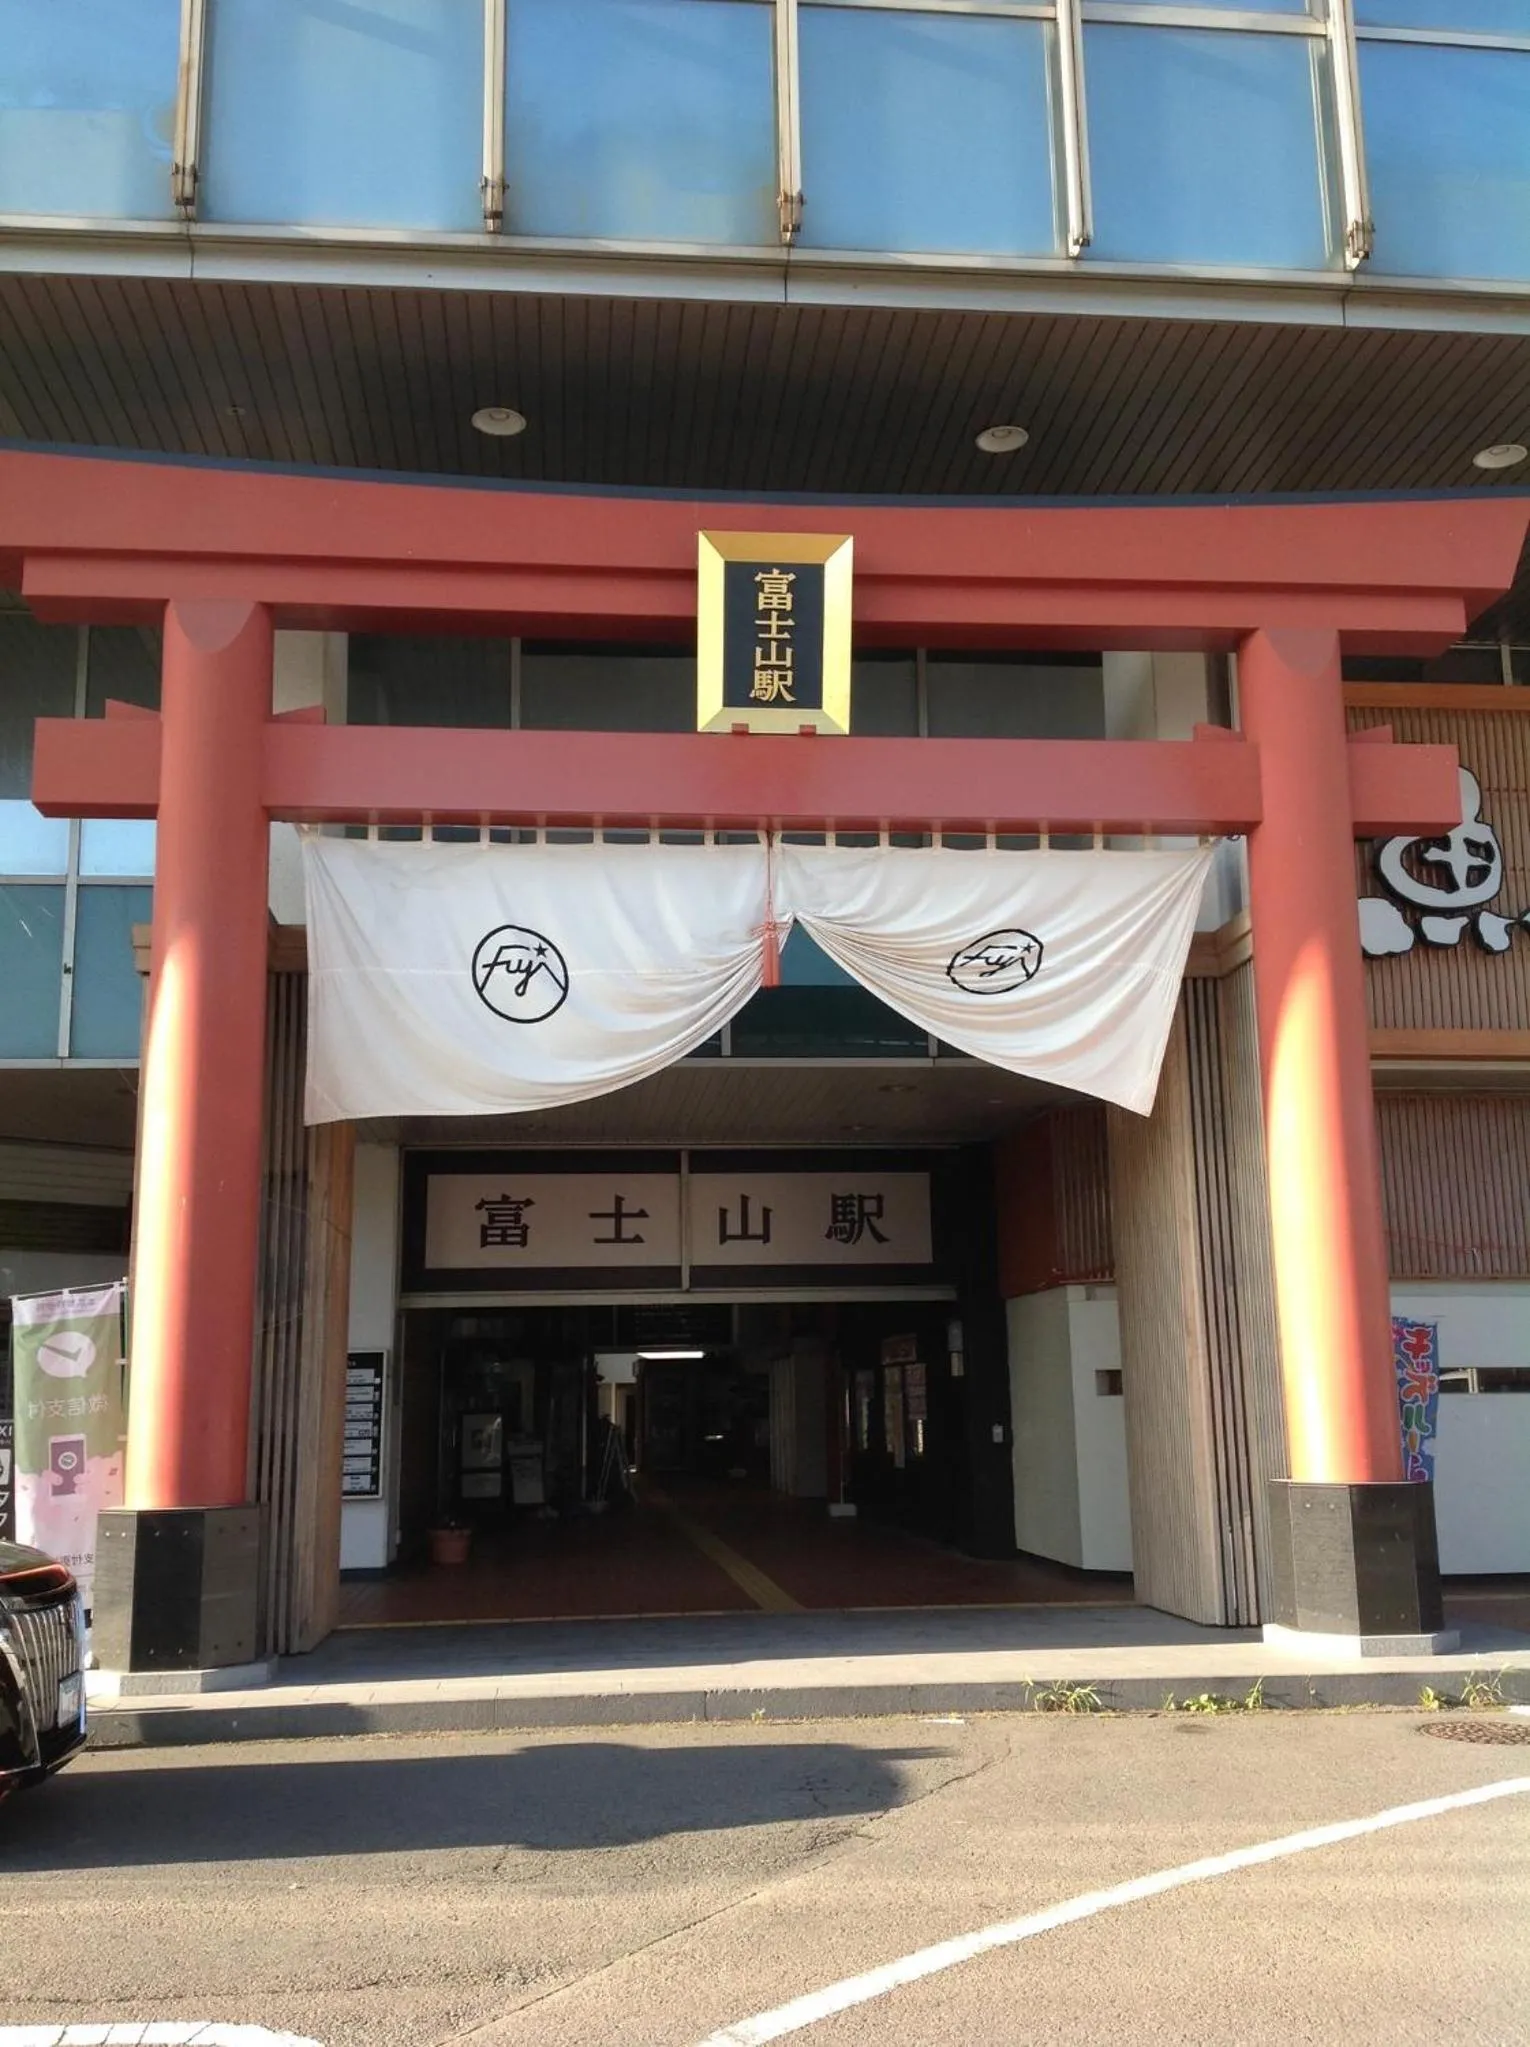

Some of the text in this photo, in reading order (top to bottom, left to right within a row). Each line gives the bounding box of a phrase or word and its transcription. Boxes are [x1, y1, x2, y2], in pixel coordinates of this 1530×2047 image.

[749, 568, 797, 703] 富士山駅
[475, 1194, 890, 1249] 富士山駅
